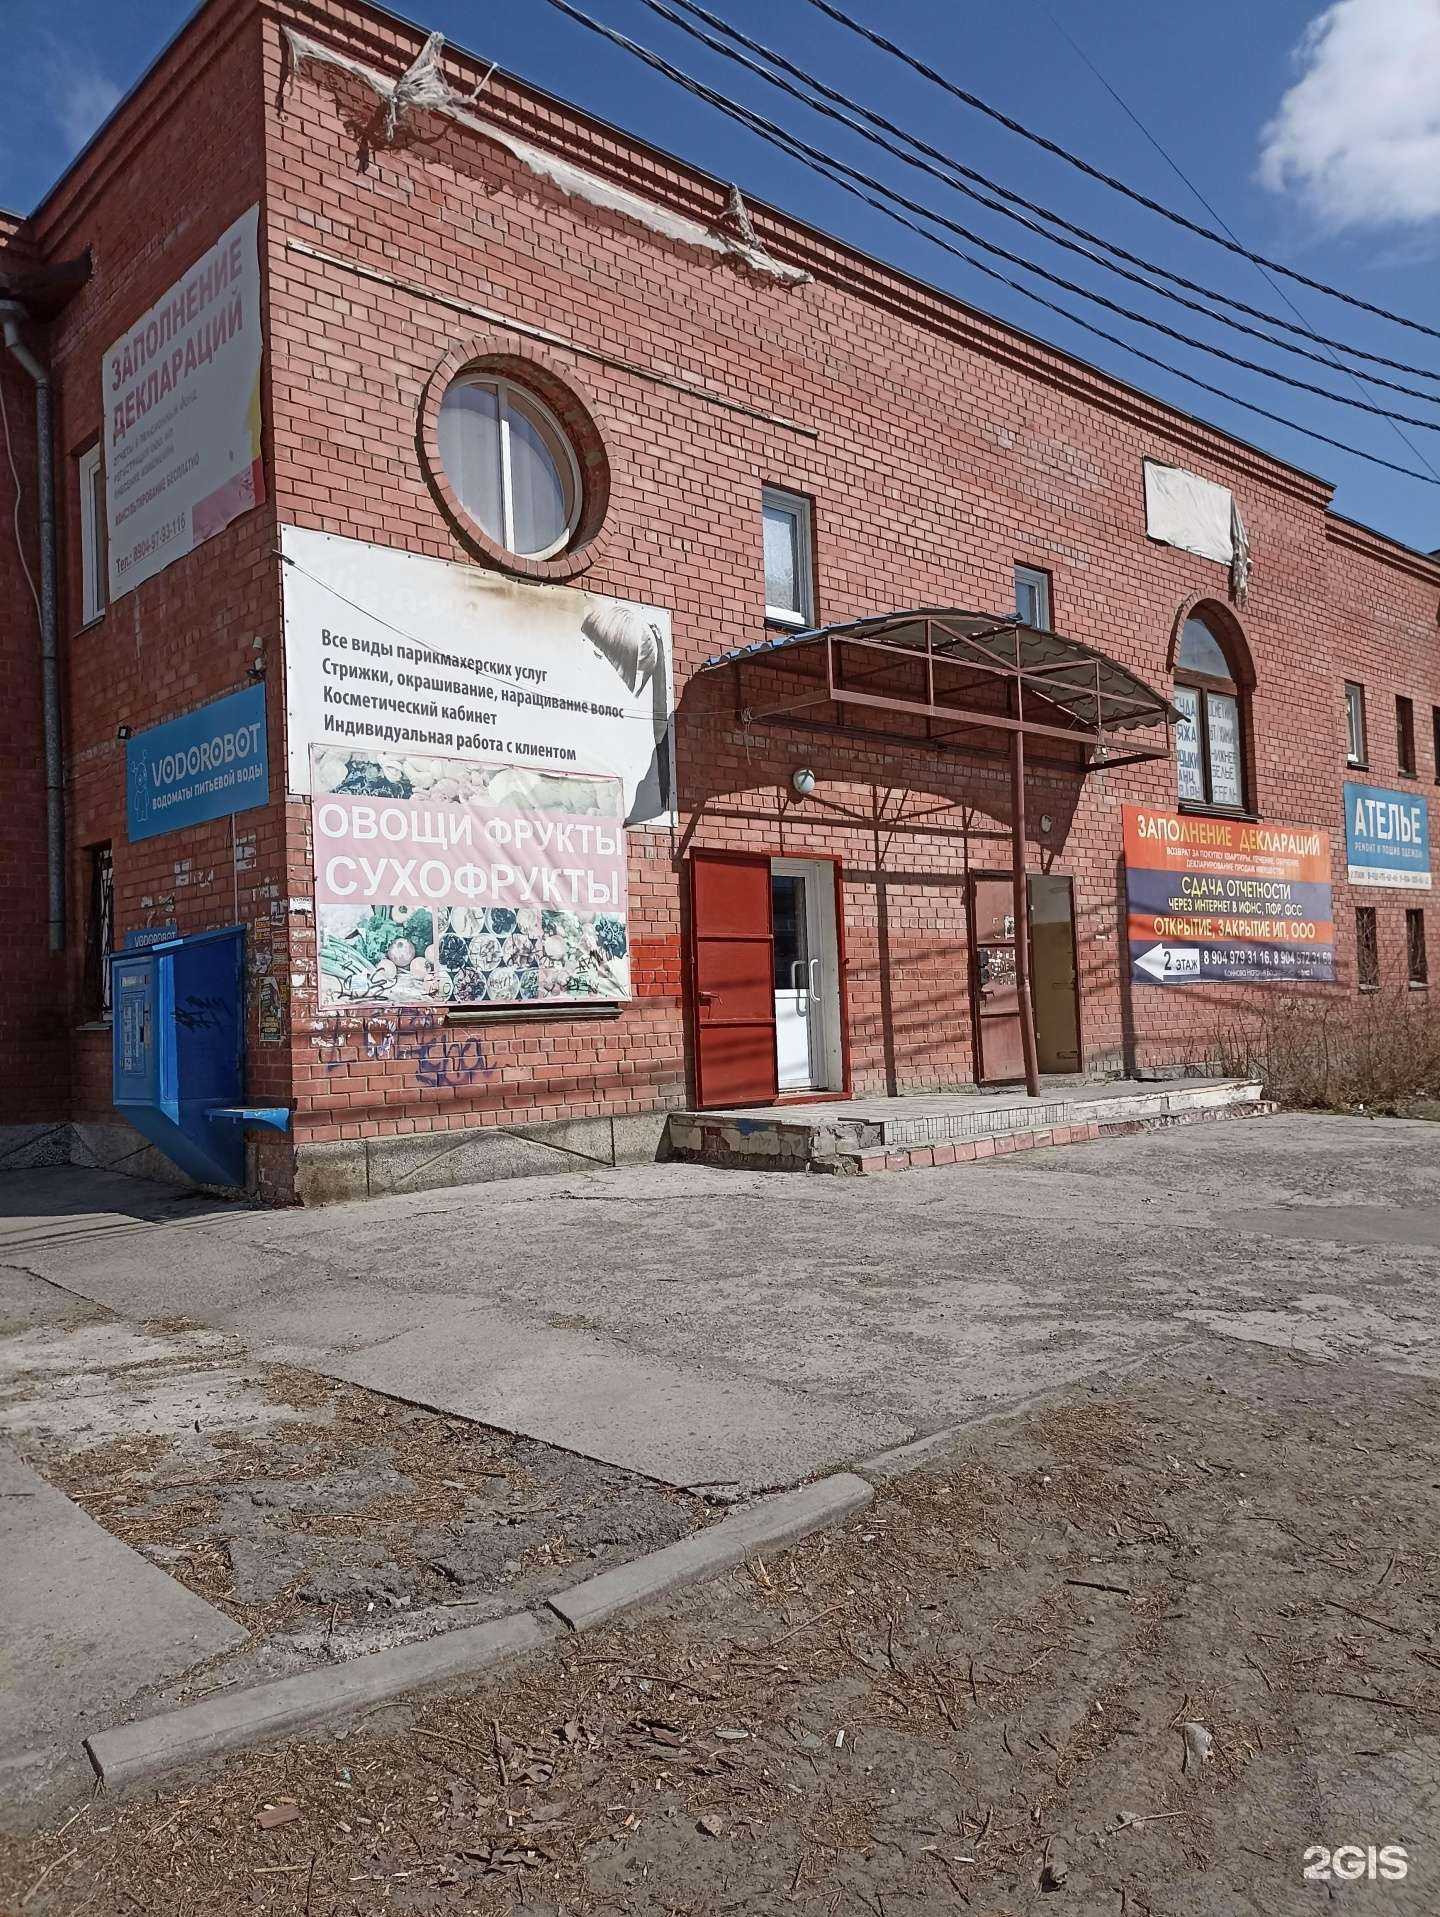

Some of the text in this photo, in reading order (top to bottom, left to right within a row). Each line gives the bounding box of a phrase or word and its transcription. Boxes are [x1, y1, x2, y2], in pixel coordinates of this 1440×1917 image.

[111, 236, 243, 391] ЗАПОЛНЕНИЕ
[112, 289, 243, 447] ДЕКЛАРАЦИЙ
[321, 629, 549, 687] Все виды парикмахерских услуг
[322, 657, 625, 719] Стрижки, окрашивание, наращивание волос
[323, 686, 498, 726] Косметический кабинет
[152, 721, 261, 788] VODOROBOT
[324, 713, 577, 761] Индивидуальная работа с клиентом
[152, 764, 263, 811] ВОДОМАТЫ ПИТЬЕВОЙ ВОДЫ
[318, 803, 623, 856] ОВОЩИ ФРУКТЫ
[1137, 815, 1320, 856] ЗАПОЛНЕНИЕ ДЕКЛАРАЦИЙ
[1354, 798, 1422, 844] АТЕЛЬЕ
[325, 854, 619, 905] СУХОФРУКТЫ
[1181, 876, 1291, 900] СДАЧА ОТЧЕТНОСТИ
[1153, 917, 1215, 938] ОТКРЫТИЕ,
[1217, 919, 1270, 938] ЗАКРЫТИЕ
[1291, 922, 1315, 938] ООО
[1168, 898, 1193, 911] ЧЕРЕЗ
[1195, 899, 1231, 913] ИНТЕРНЕТ
[1232, 901, 1238, 913] В
[1285, 904, 1303, 917] ФСС
[1163, 951, 1198, 971] 2 ЭТАЖ
[1203, 950, 1210, 964] 8
[1211, 950, 1228, 965] 904
[1229, 950, 1246, 965] 979
[1247, 950, 1258, 965] 31
[1273, 950, 1279, 965] 8
[1280, 951, 1296, 965] 904
